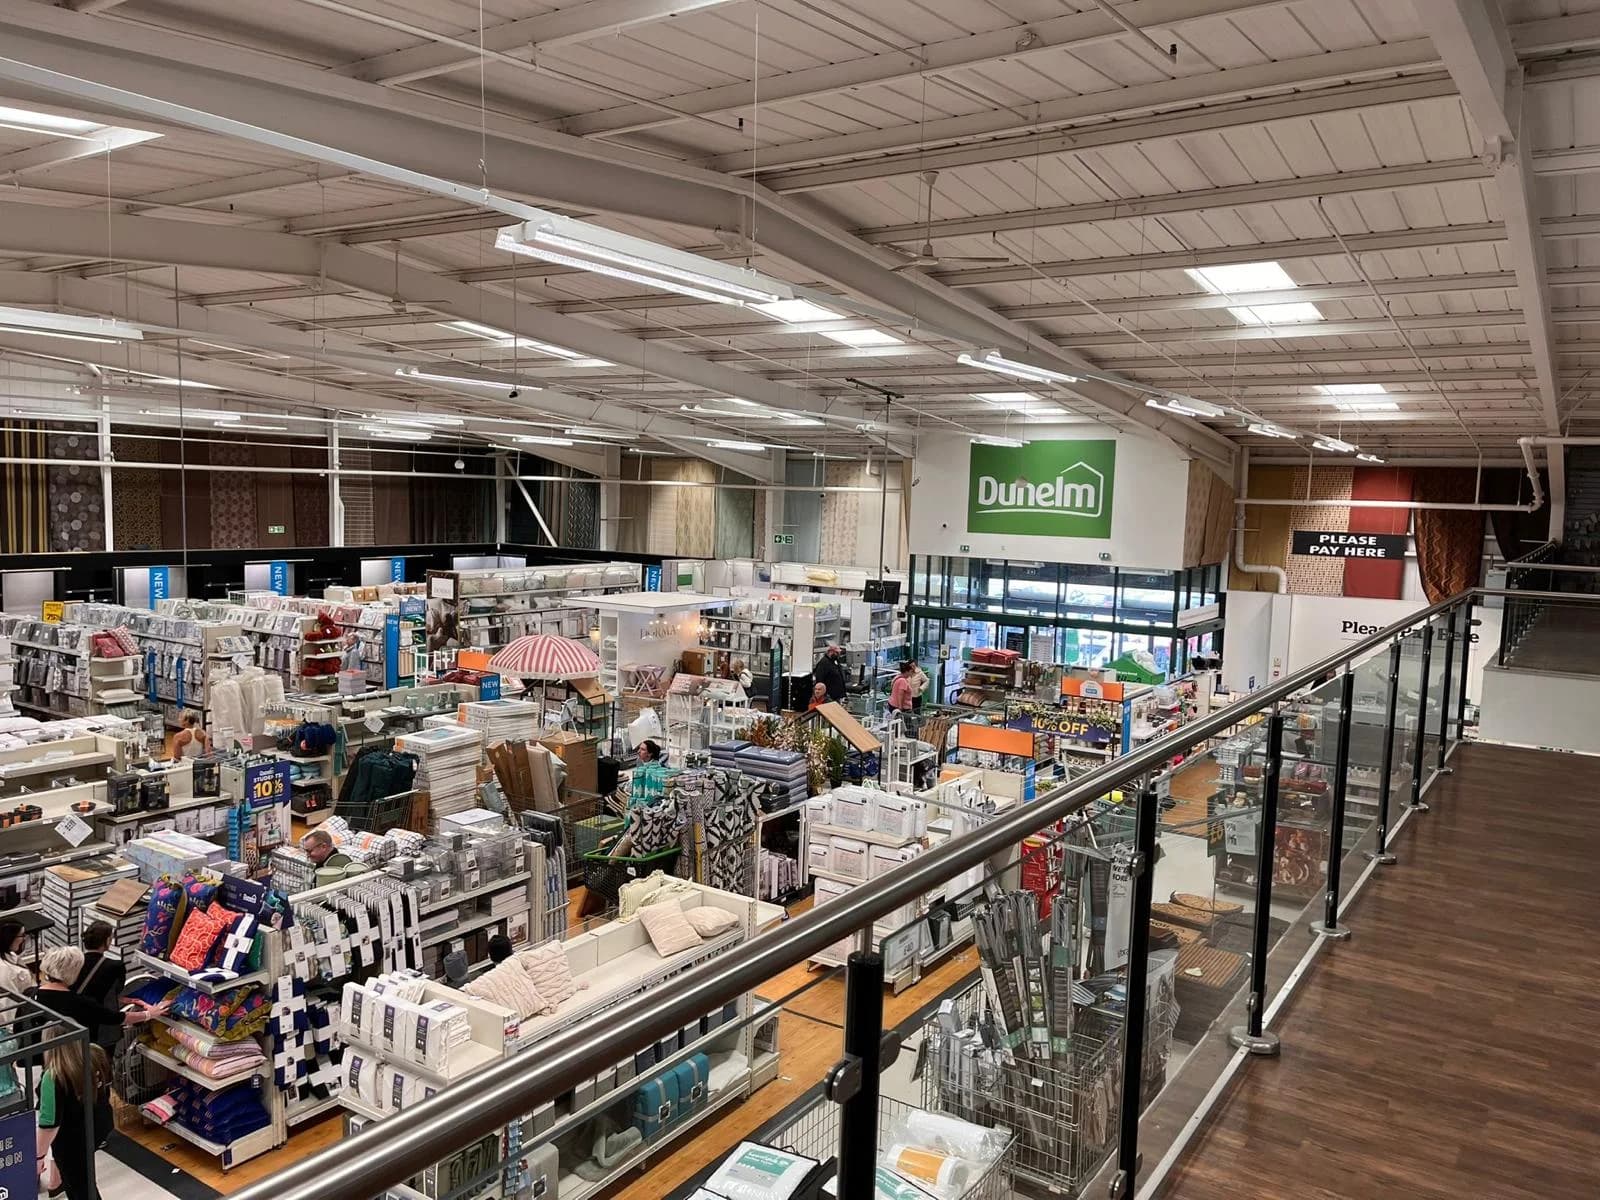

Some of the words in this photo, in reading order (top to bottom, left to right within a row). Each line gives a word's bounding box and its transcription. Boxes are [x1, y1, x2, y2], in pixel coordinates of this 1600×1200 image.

[978, 476, 1095, 507] Dunelm
[1320, 535, 1377, 545] PLEASE
[1309, 546, 1339, 555] PAY
[1344, 547, 1386, 557] HERE
[275, 566, 283, 590] NEW
[154, 572, 164, 599] NEW
[1341, 621, 1385, 635] Plea
[482, 681, 499, 689] NEW
[1059, 721, 1089, 736] OFF
